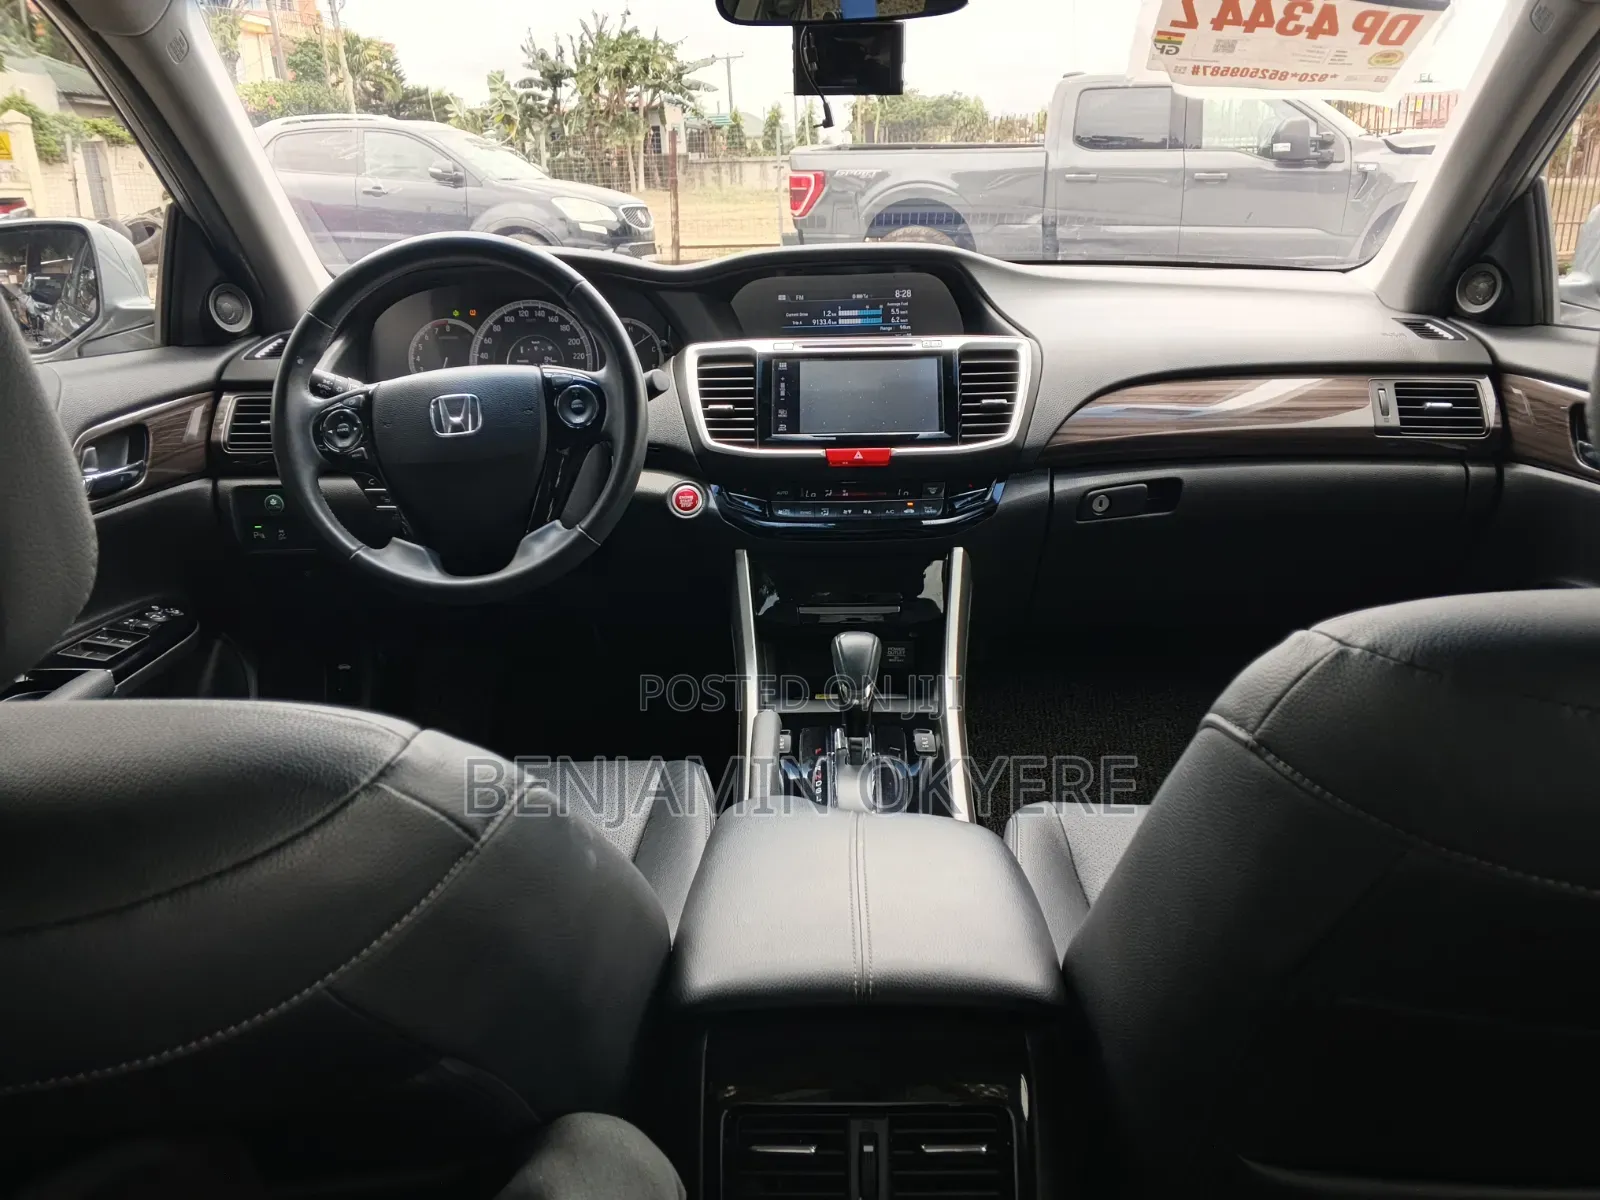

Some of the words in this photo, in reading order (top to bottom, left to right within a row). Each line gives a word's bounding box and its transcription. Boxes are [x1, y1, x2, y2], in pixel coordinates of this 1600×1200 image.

[894, 289, 912, 298] 8:28
[548, 315, 559, 323] 160
[492, 324, 501, 332] 80
[560, 324, 571, 332] 180
[567, 338, 581, 346] 200
[480, 352, 489, 360] 40
[572, 352, 586, 360] 220
